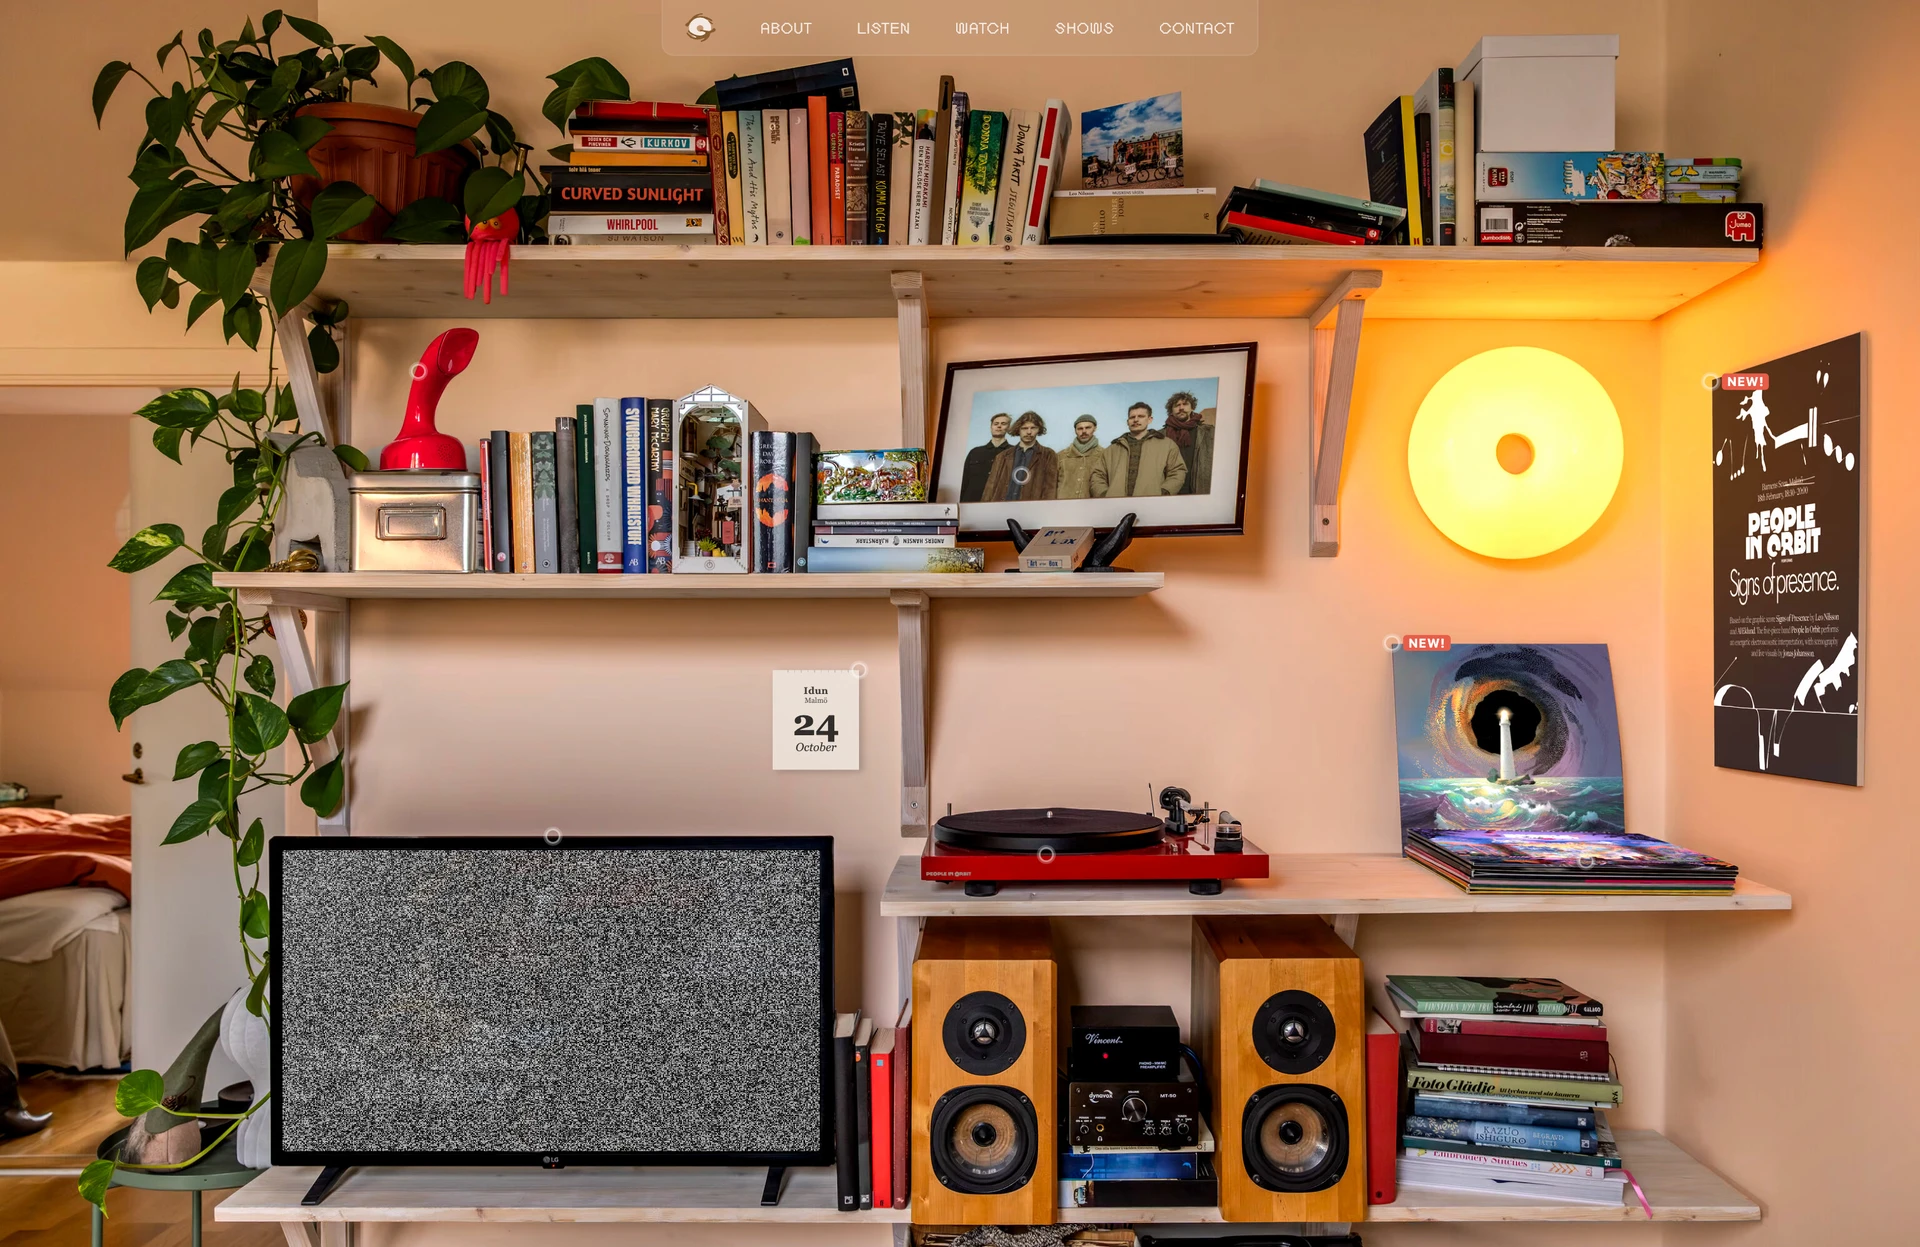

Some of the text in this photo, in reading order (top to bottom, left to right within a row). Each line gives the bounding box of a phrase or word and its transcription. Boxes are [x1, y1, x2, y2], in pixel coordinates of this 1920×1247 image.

[745, 115, 754, 131] The
[647, 139, 687, 148] KURKOV
[976, 114, 992, 186] DONNA TARTT
[748, 158, 758, 179] And
[1006, 124, 1030, 234] DONNA TARTT STEGLITSAN
[562, 187, 703, 204] CURVED SUNLIGHT
[750, 181, 758, 198] His
[876, 180, 886, 204] KOMMA
[747, 201, 759, 230] Myths
[876, 207, 885, 222] OCH
[607, 219, 658, 230] WHIRLPOOL
[661, 407, 670, 443] GRUPPEN
[651, 407, 660, 472] MARY McCARTHY
[626, 408, 642, 545] SYNCHRONIZED WHALESTUFF
[1748, 503, 1816, 536] PEOPLE
[1746, 527, 1821, 560] IN ORBIT
[655, 557, 666, 565] AB
[1730, 562, 1840, 606] Signs of presence.
[804, 686, 828, 694] Idun
[794, 715, 838, 742] 24
[796, 742, 837, 752] October
[1522, 1004, 1534, 1012] LIV
[1085, 1033, 1122, 1044] Vincent
[1476, 1133, 1526, 1144] ISHIGURO
[1484, 1126, 1519, 1136] KAZUO
